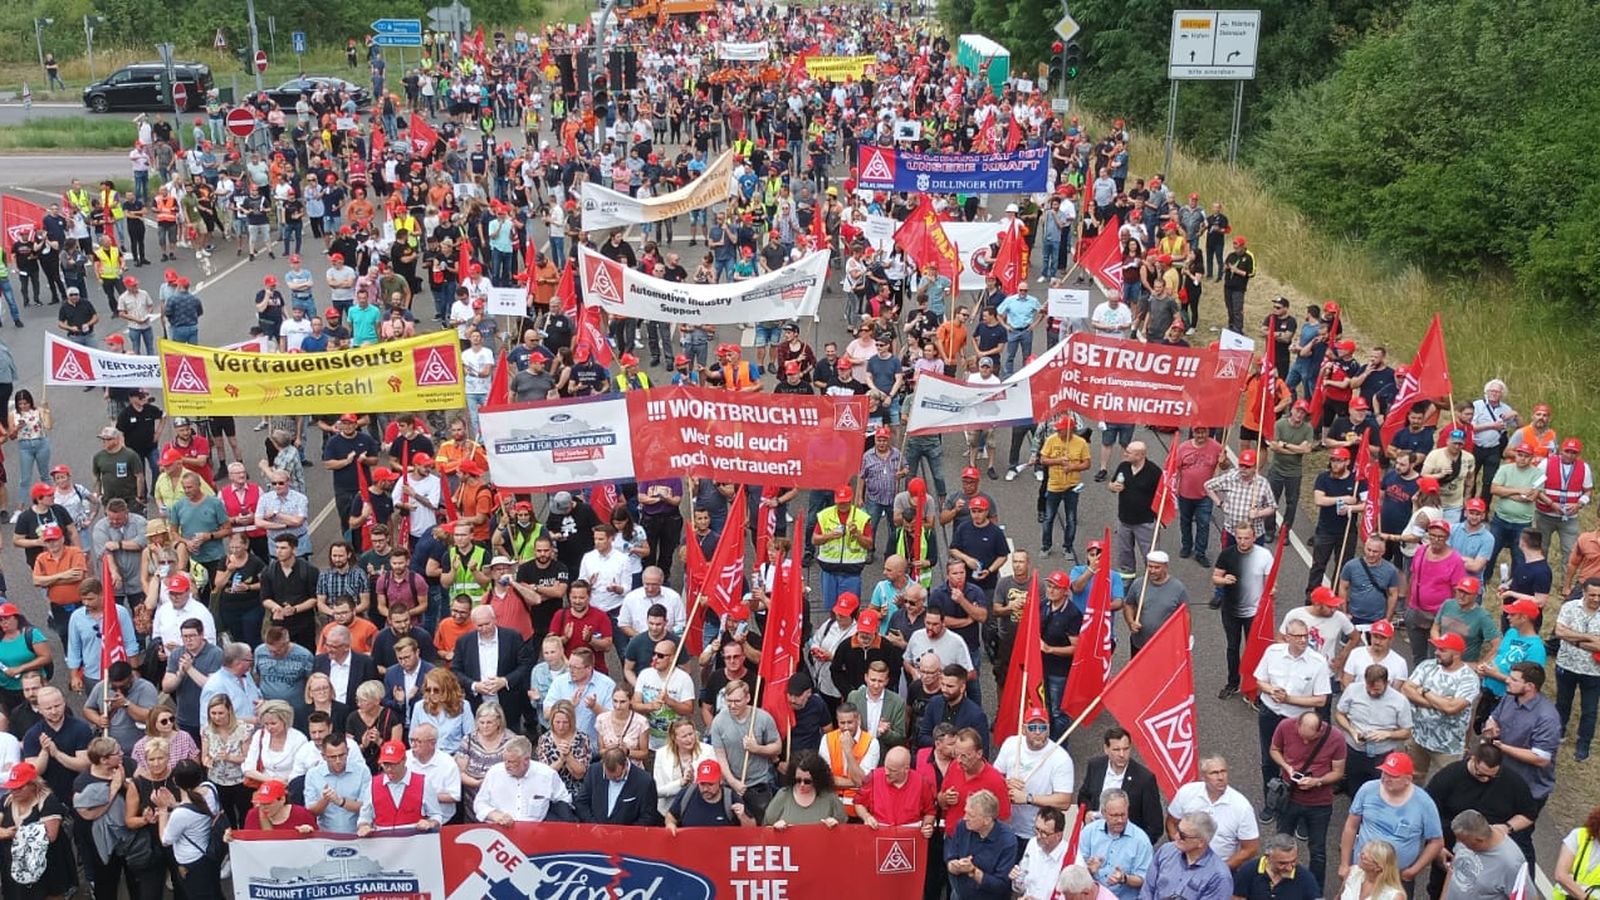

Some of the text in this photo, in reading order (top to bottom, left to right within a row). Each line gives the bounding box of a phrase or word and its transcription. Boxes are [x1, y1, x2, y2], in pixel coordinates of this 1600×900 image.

[906, 160, 1040, 173] UNSERE KRAFT
[932, 179, 1024, 190] DILLINGER HÜTTE
[630, 284, 687, 304] Automotive
[660, 303, 701, 316] Support
[213, 347, 404, 373] Vertrauensleute
[1073, 341, 1171, 375] BETRUG
[1174, 356, 1200, 378] !!!
[284, 377, 373, 398] saarstahl
[1090, 376, 1106, 384] Ford
[1093, 392, 1123, 411] FÜR
[646, 399, 818, 426] !!! WORTBRUCH !!!
[499, 436, 612, 453] ZUKUNFT FÜR DAS SAARLAND
[681, 427, 787, 452] Wer soll euch
[670, 450, 801, 476] noch vertrauen?!
[730, 845, 799, 872] FEEL
[255, 882, 413, 899] ZUKUNFT FÜR DAS SAARLAND
[730, 880, 789, 900] THE
